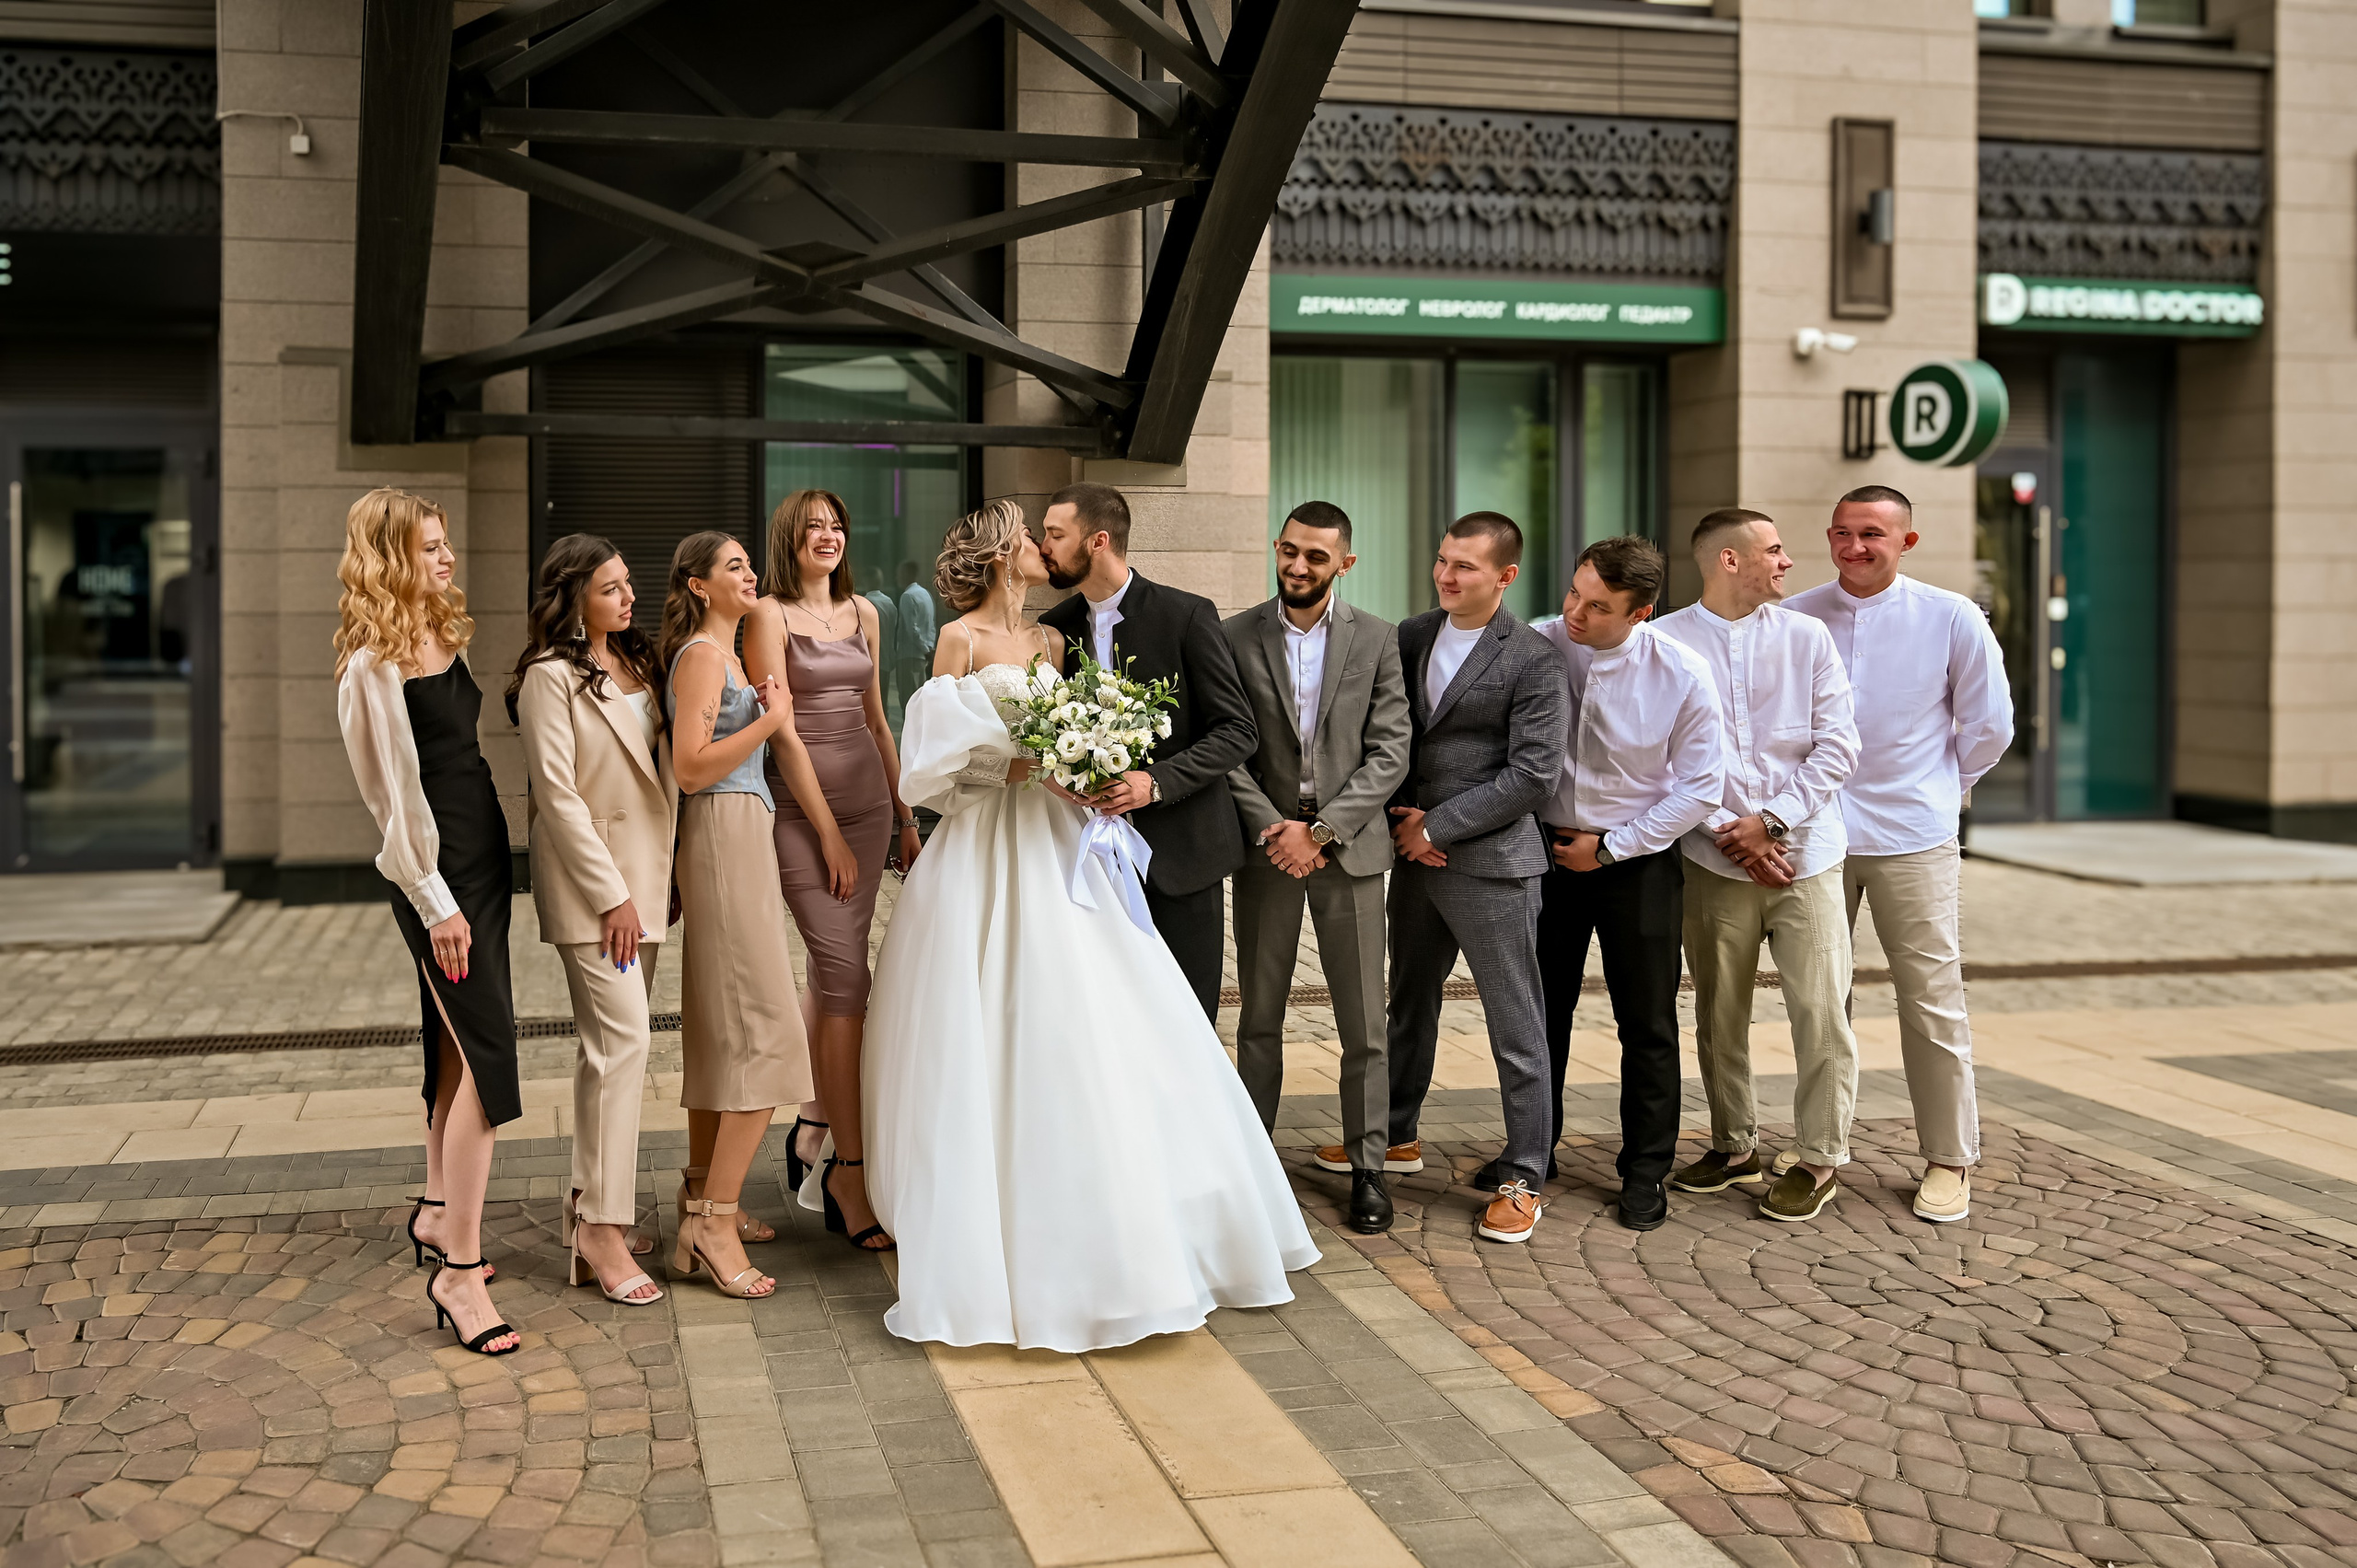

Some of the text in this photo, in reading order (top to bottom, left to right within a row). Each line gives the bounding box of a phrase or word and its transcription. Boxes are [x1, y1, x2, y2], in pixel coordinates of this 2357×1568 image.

[1297, 296, 1693, 325] ДЕРМАТОЛОГ НЕВРОЛОГ КАРДИОЛОГ ПЕДИАТР
[2029, 285, 2141, 320] REGINA
[2143, 290, 2264, 324] DOCTOR
